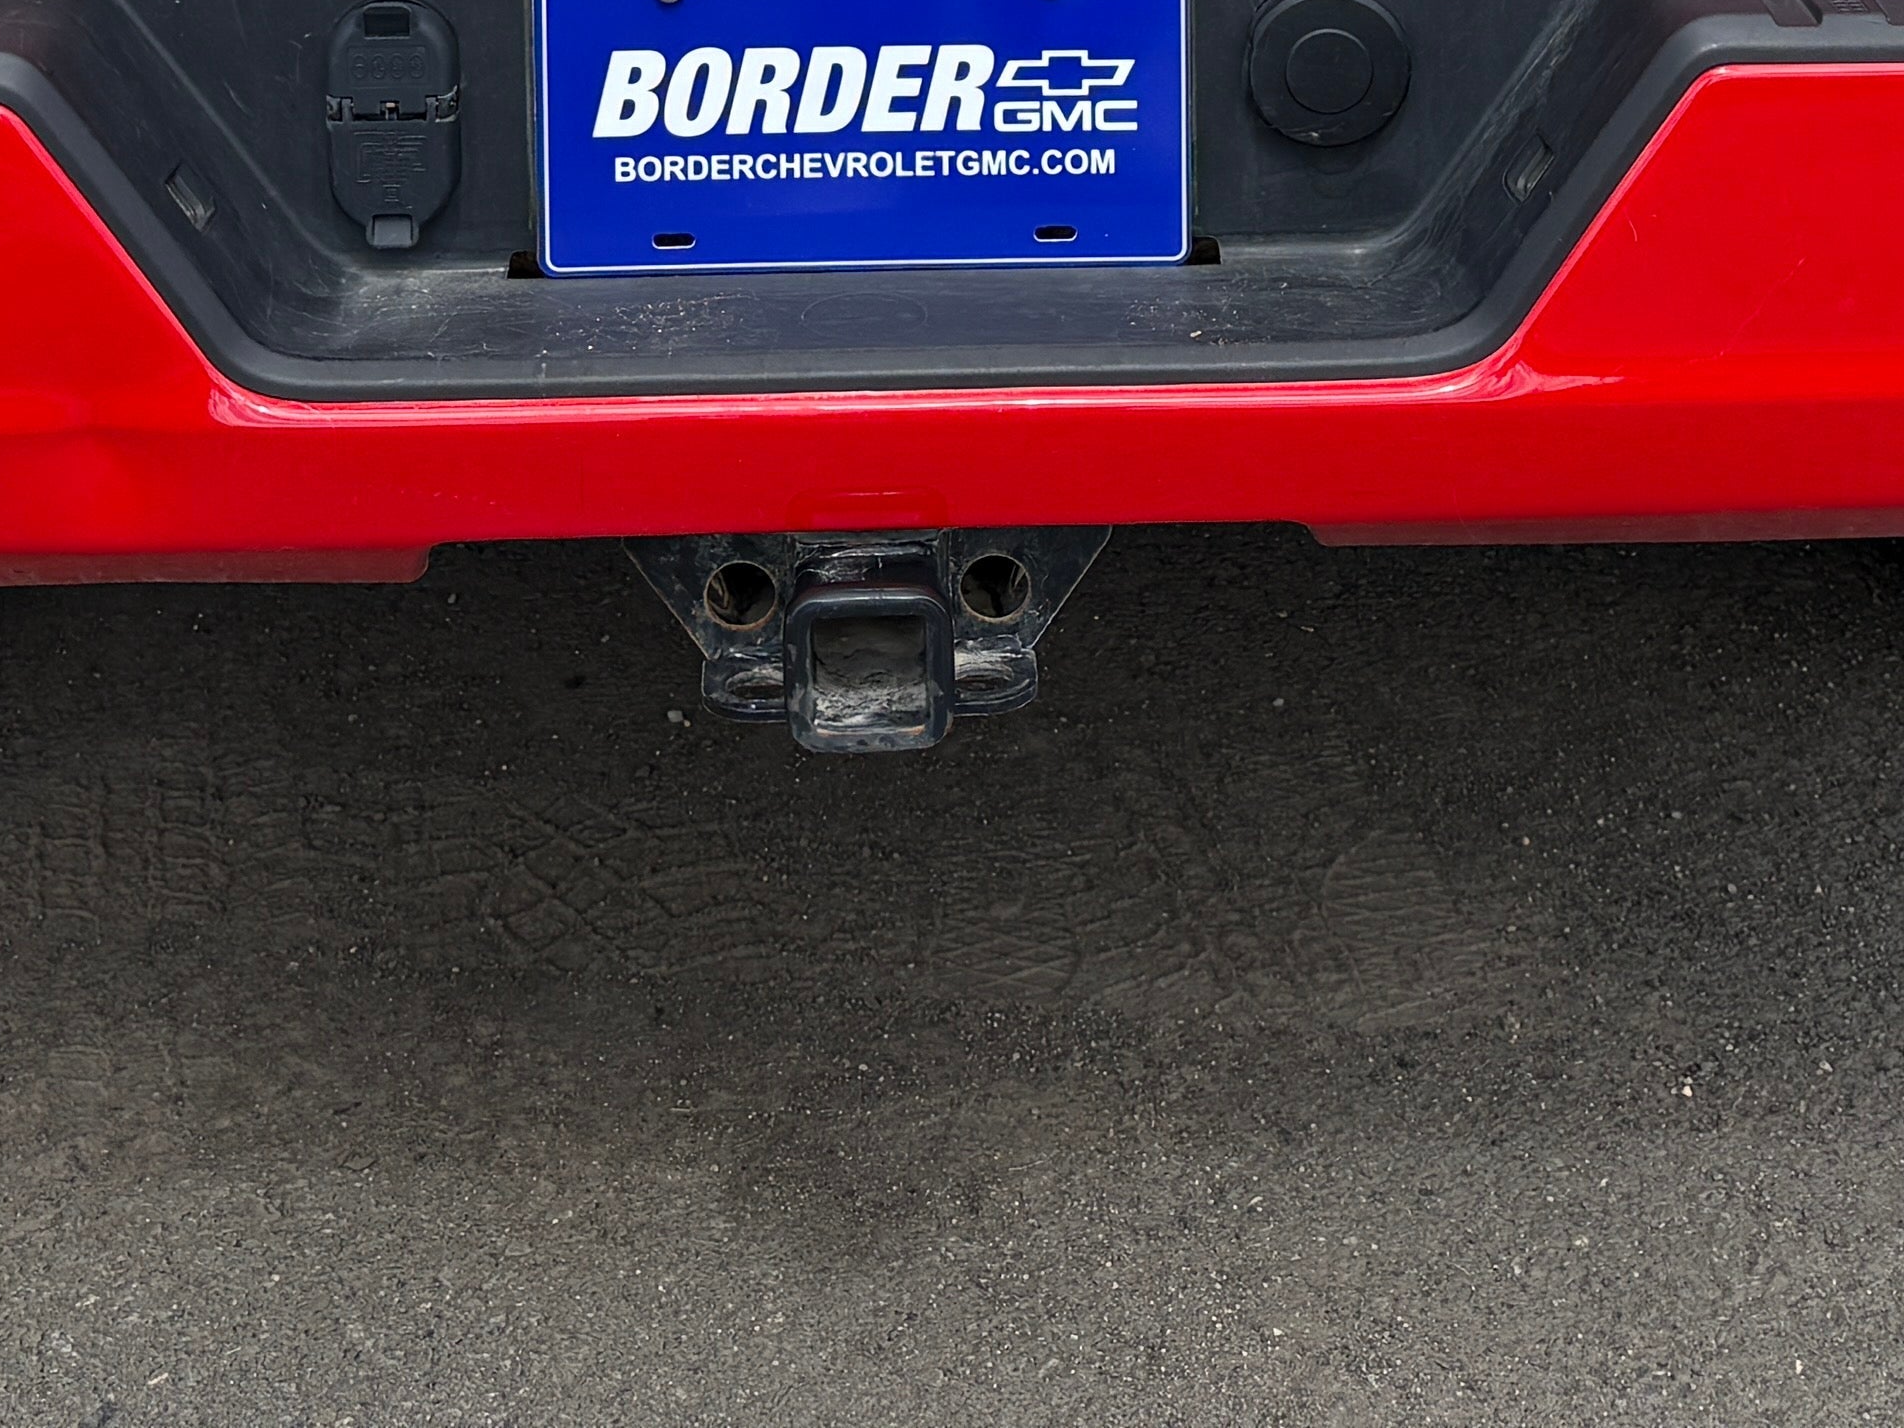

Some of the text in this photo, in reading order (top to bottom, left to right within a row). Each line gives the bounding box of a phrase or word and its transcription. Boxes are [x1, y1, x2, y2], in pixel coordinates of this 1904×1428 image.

[592, 43, 1138, 138] BORDER GMC
[614, 148, 1116, 183] BORDERCHEVROLETGMC.COM
